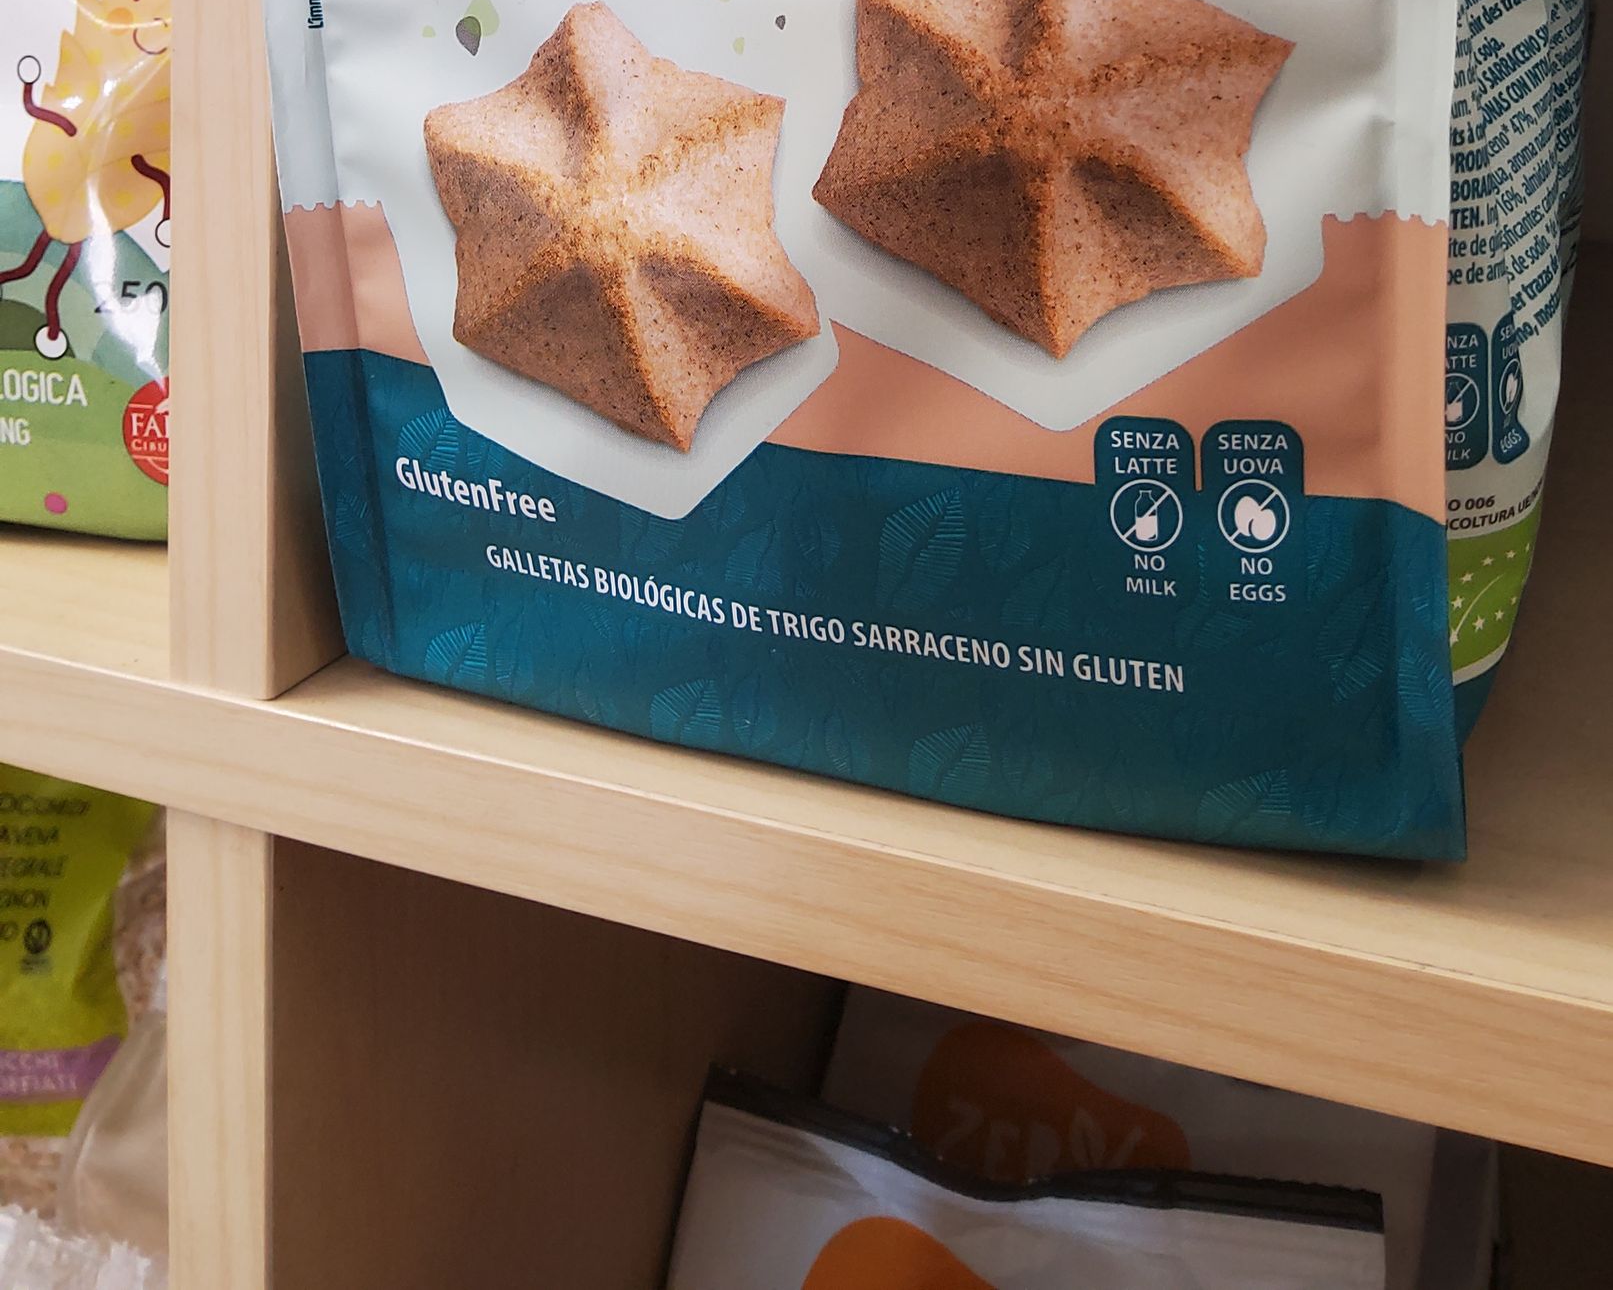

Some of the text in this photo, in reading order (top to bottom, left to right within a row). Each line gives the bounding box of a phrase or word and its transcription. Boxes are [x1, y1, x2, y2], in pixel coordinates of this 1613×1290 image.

[1482, 35, 1541, 89] SARRACENO
[1506, 76, 1533, 103] CON
[1508, 142, 1538, 173] aroma
[1470, 234, 1487, 256] de
[1466, 262, 1484, 284] de
[0, 368, 88, 407] OGICA
[1110, 431, 1180, 451] SENZA
[1217, 434, 1289, 451] SENZA
[1114, 457, 1178, 475] LATTE
[1223, 458, 1284, 475] UOVA
[395, 457, 557, 522] GlutenFree
[1464, 495, 1496, 510] 006
[1133, 554, 1166, 572] NO
[1240, 557, 1273, 575] NO
[1126, 576, 1177, 597] MILK
[1229, 583, 1287, 603] EGGS
[486, 545, 1185, 693] GALLETAS BIOLÓGICAS DE TRIGO SARRACENO SIN GLUTEN
